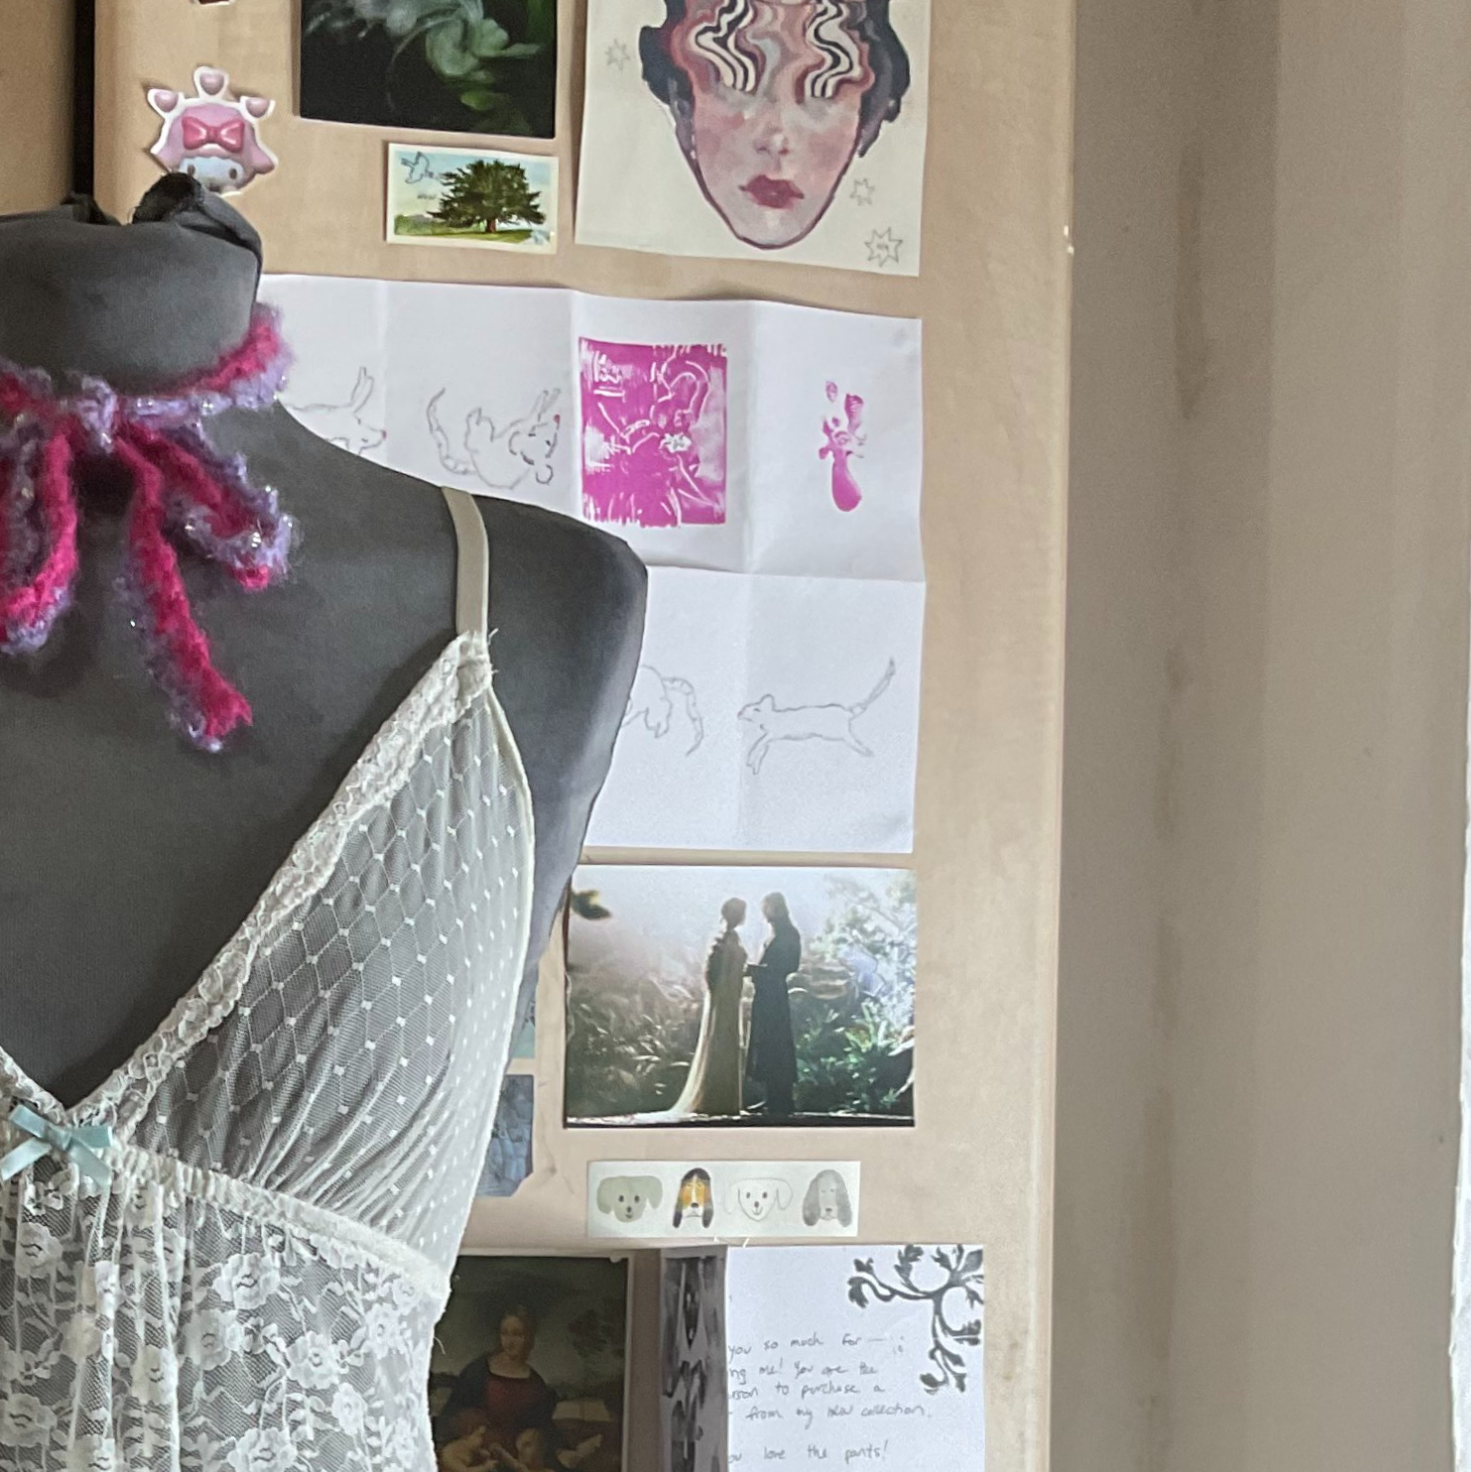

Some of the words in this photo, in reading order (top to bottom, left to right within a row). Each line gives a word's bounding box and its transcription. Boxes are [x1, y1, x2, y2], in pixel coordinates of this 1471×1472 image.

[729, 1344, 752, 1363] you
[764, 1340, 779, 1351] so
[791, 1332, 824, 1347] much
[775, 1382, 790, 1396] to
[801, 1380, 861, 1399] purchase
[874, 1383, 886, 1393] a
[745, 1406, 784, 1421] from
[796, 1408, 814, 1430] my
[764, 1446, 786, 1460] love
[807, 1444, 828, 1460] the
[845, 1439, 889, 1465] pants!
